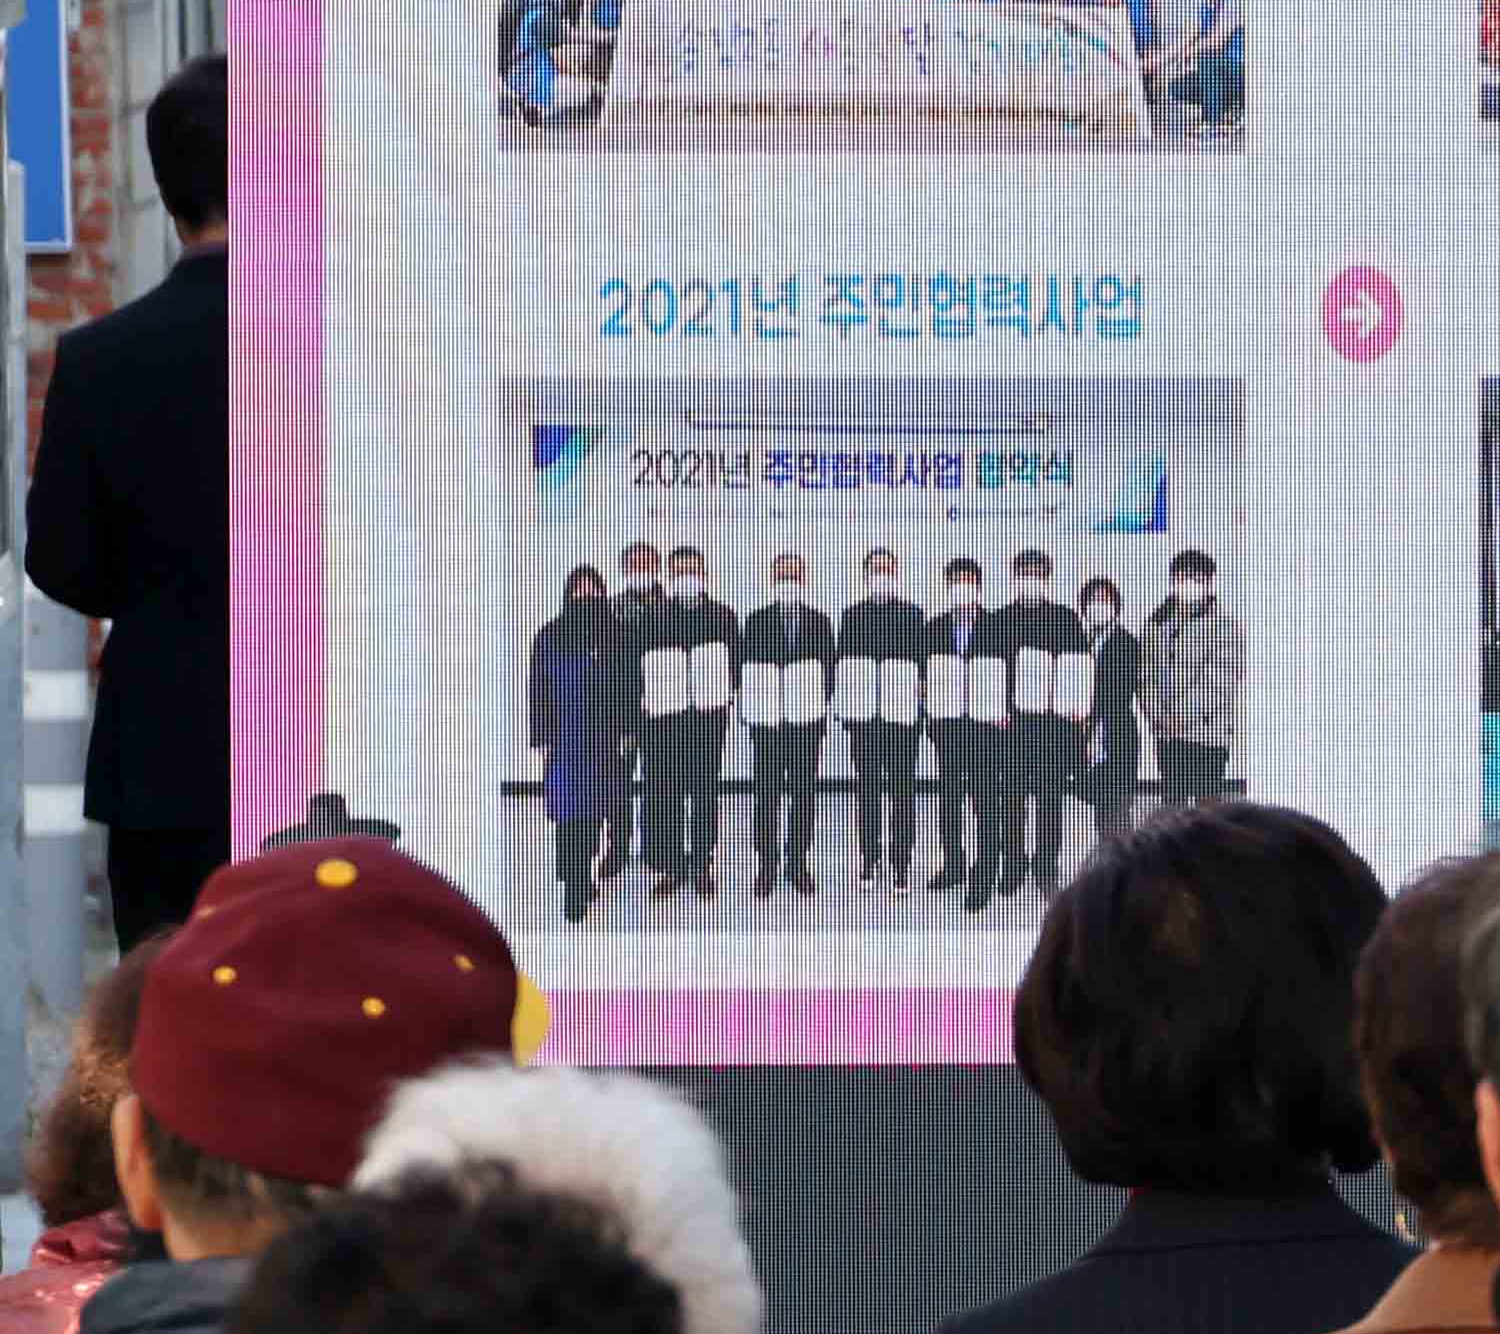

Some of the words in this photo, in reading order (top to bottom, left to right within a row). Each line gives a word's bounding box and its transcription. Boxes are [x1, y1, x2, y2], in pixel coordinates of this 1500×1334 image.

[599, 275, 798, 341] 2021년
[818, 273, 1144, 341] 주민협력사업
[631, 448, 751, 491] 2021년
[762, 447, 965, 492] 주민협력사업
